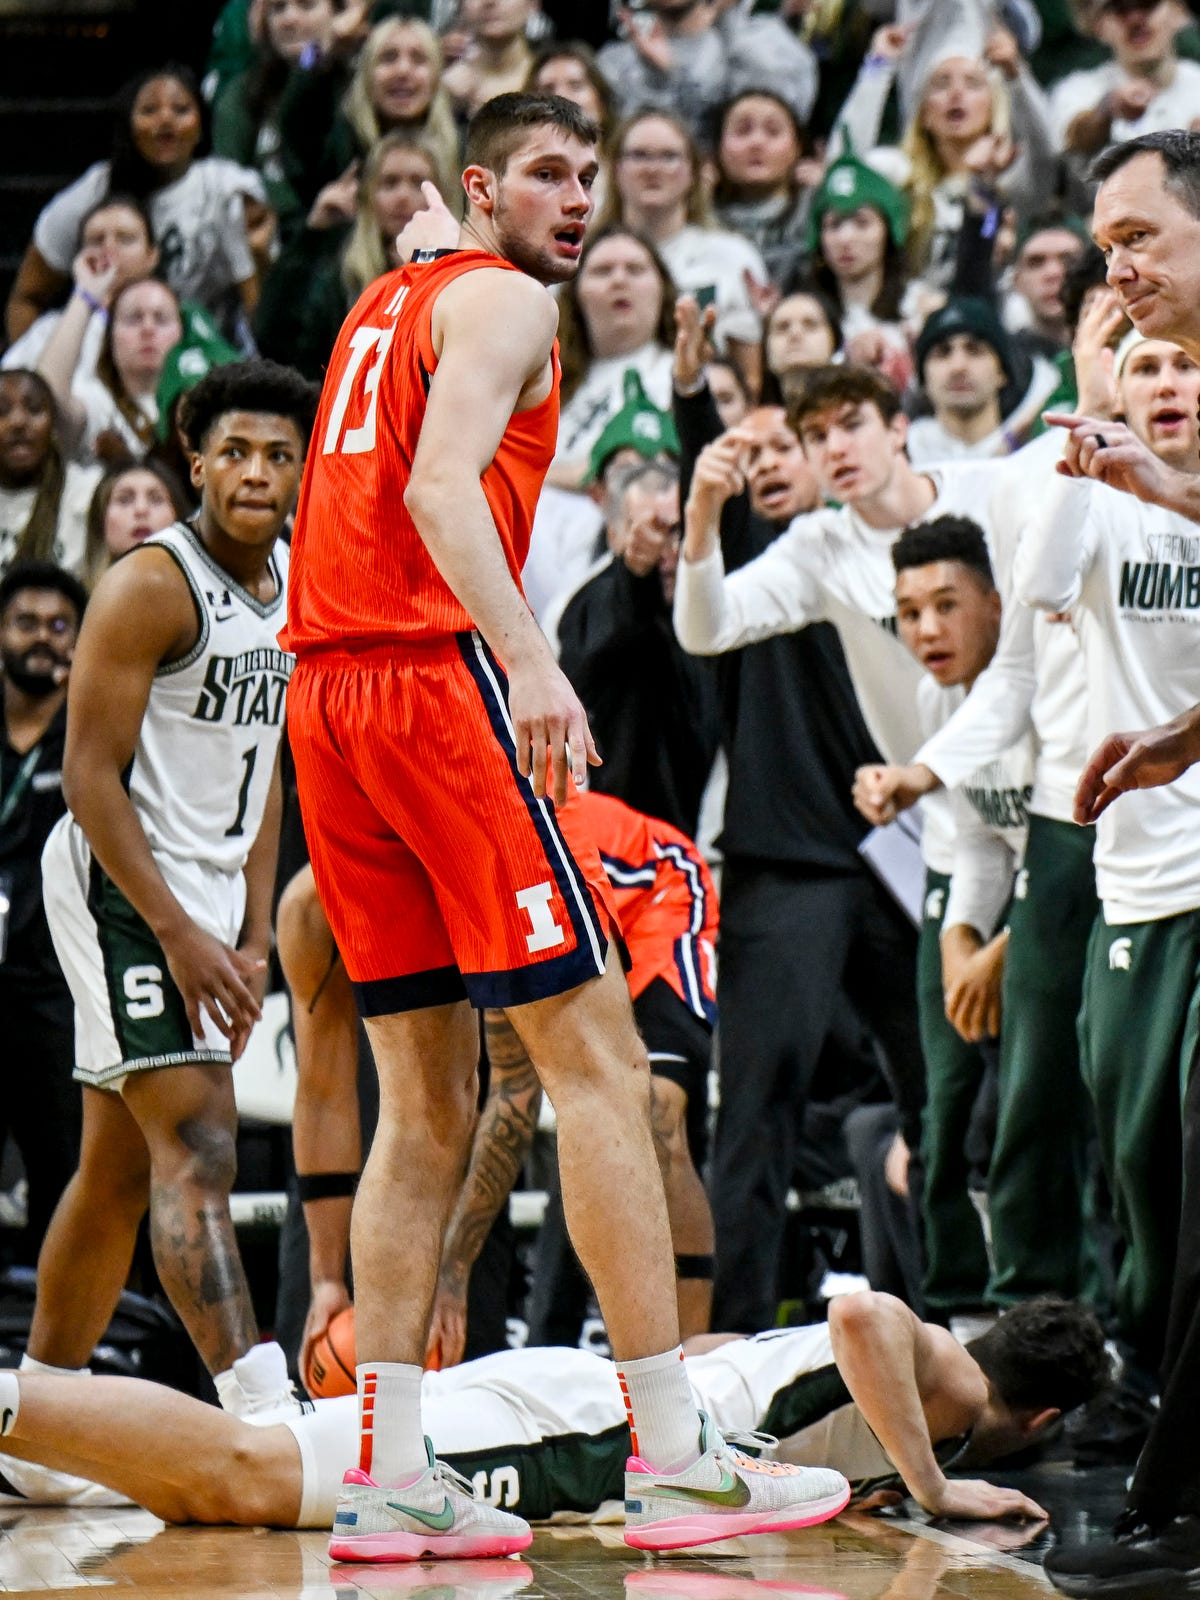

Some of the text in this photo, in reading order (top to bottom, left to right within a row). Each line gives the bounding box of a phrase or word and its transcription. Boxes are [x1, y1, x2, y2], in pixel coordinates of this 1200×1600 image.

[322, 317, 398, 456] 13
[224, 744, 259, 837] 1
[515, 881, 565, 953] I
[122, 964, 165, 1020] S
[470, 1465, 520, 1509] S
